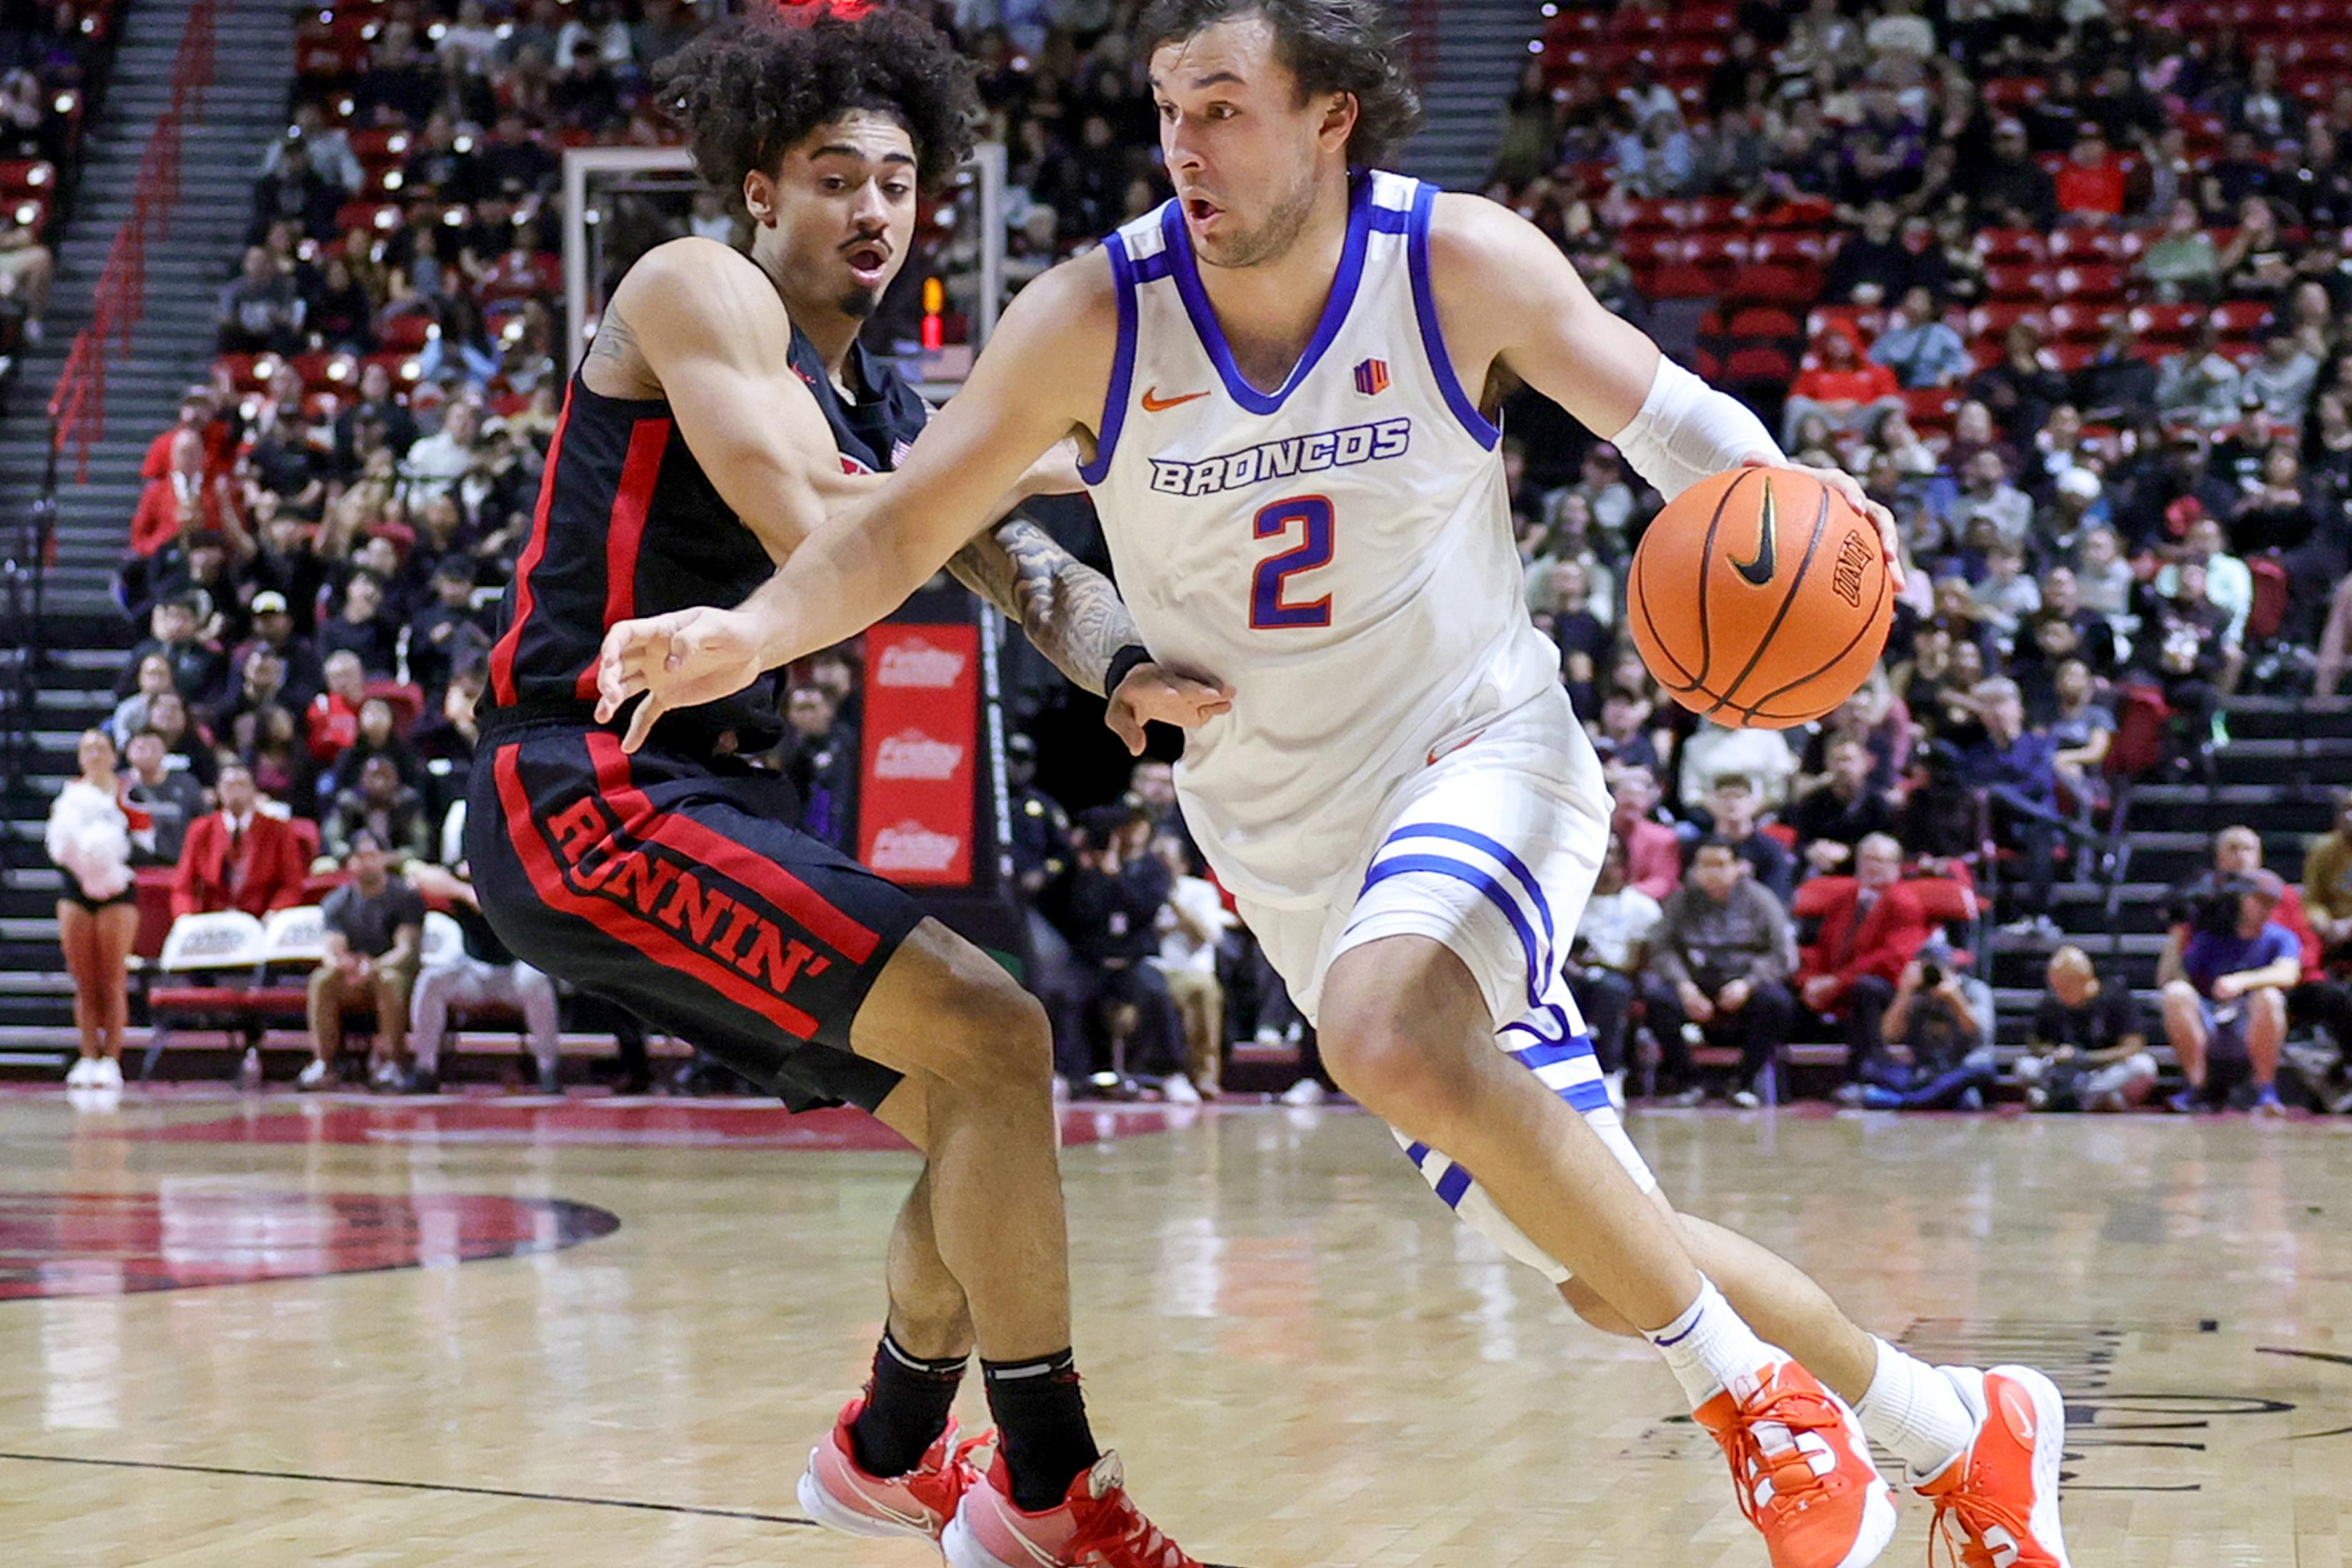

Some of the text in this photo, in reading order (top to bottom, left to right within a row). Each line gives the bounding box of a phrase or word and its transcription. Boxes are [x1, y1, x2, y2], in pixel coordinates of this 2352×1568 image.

[1148, 417, 1411, 496] BRONCOS
[1249, 495, 1335, 630] 2
[1832, 529, 1874, 607] UNLV
